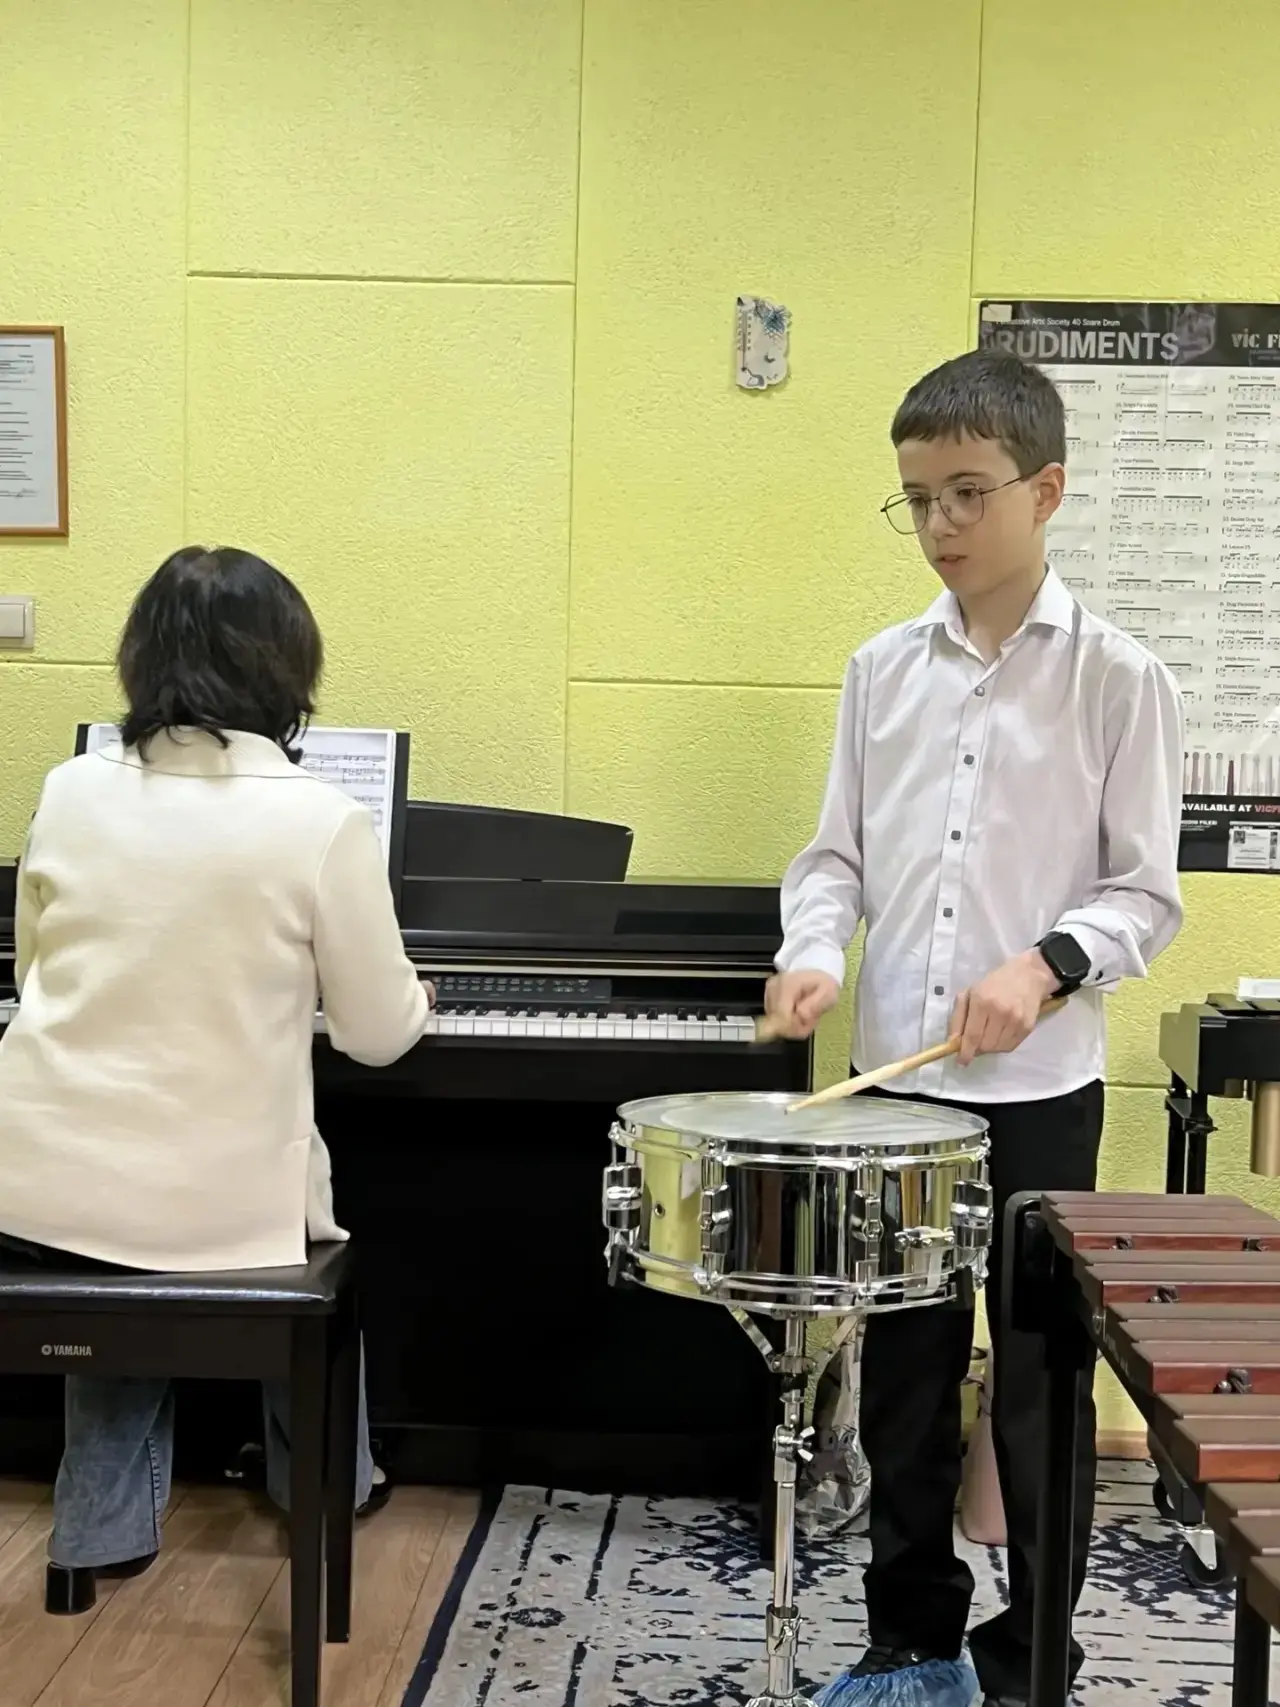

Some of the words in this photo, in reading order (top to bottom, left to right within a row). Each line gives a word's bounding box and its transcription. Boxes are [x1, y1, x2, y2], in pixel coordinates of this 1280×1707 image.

[996, 330, 1179, 360] RUDIMENTS
[1181, 803, 1236, 812] AVAILABLE
[1238, 804, 1252, 812] AT
[53, 1344, 92, 1356] YAMAHA
